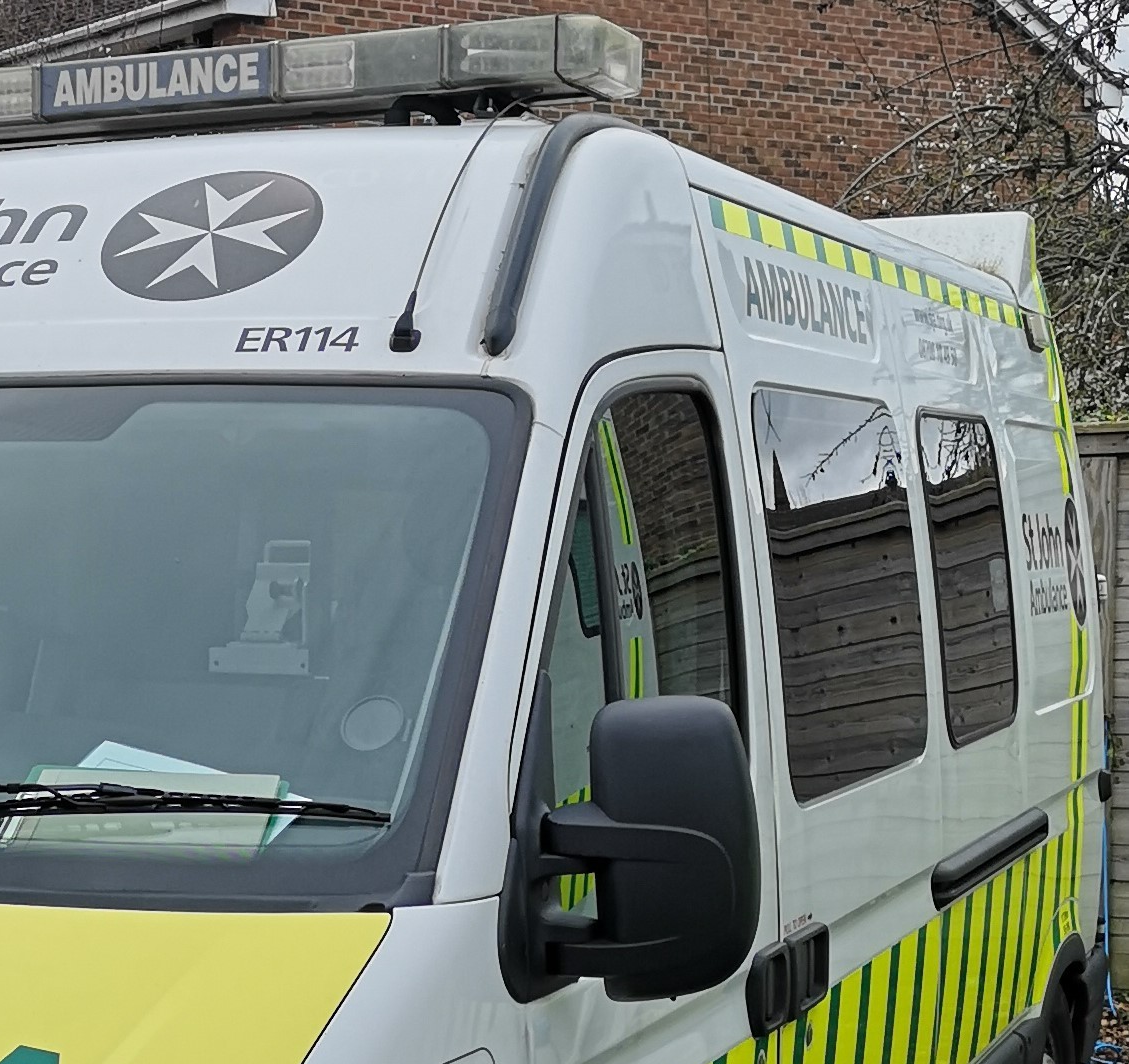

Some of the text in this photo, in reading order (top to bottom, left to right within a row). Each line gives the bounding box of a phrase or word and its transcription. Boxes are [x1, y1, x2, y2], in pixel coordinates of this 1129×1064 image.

[53, 52, 260, 107] AMBULANCE
[743, 255, 868, 345] AMBULANCE
[234, 326, 360, 352] ER114
[1022, 513, 1065, 571] St John
[1030, 577, 1068, 616] Ambulance
